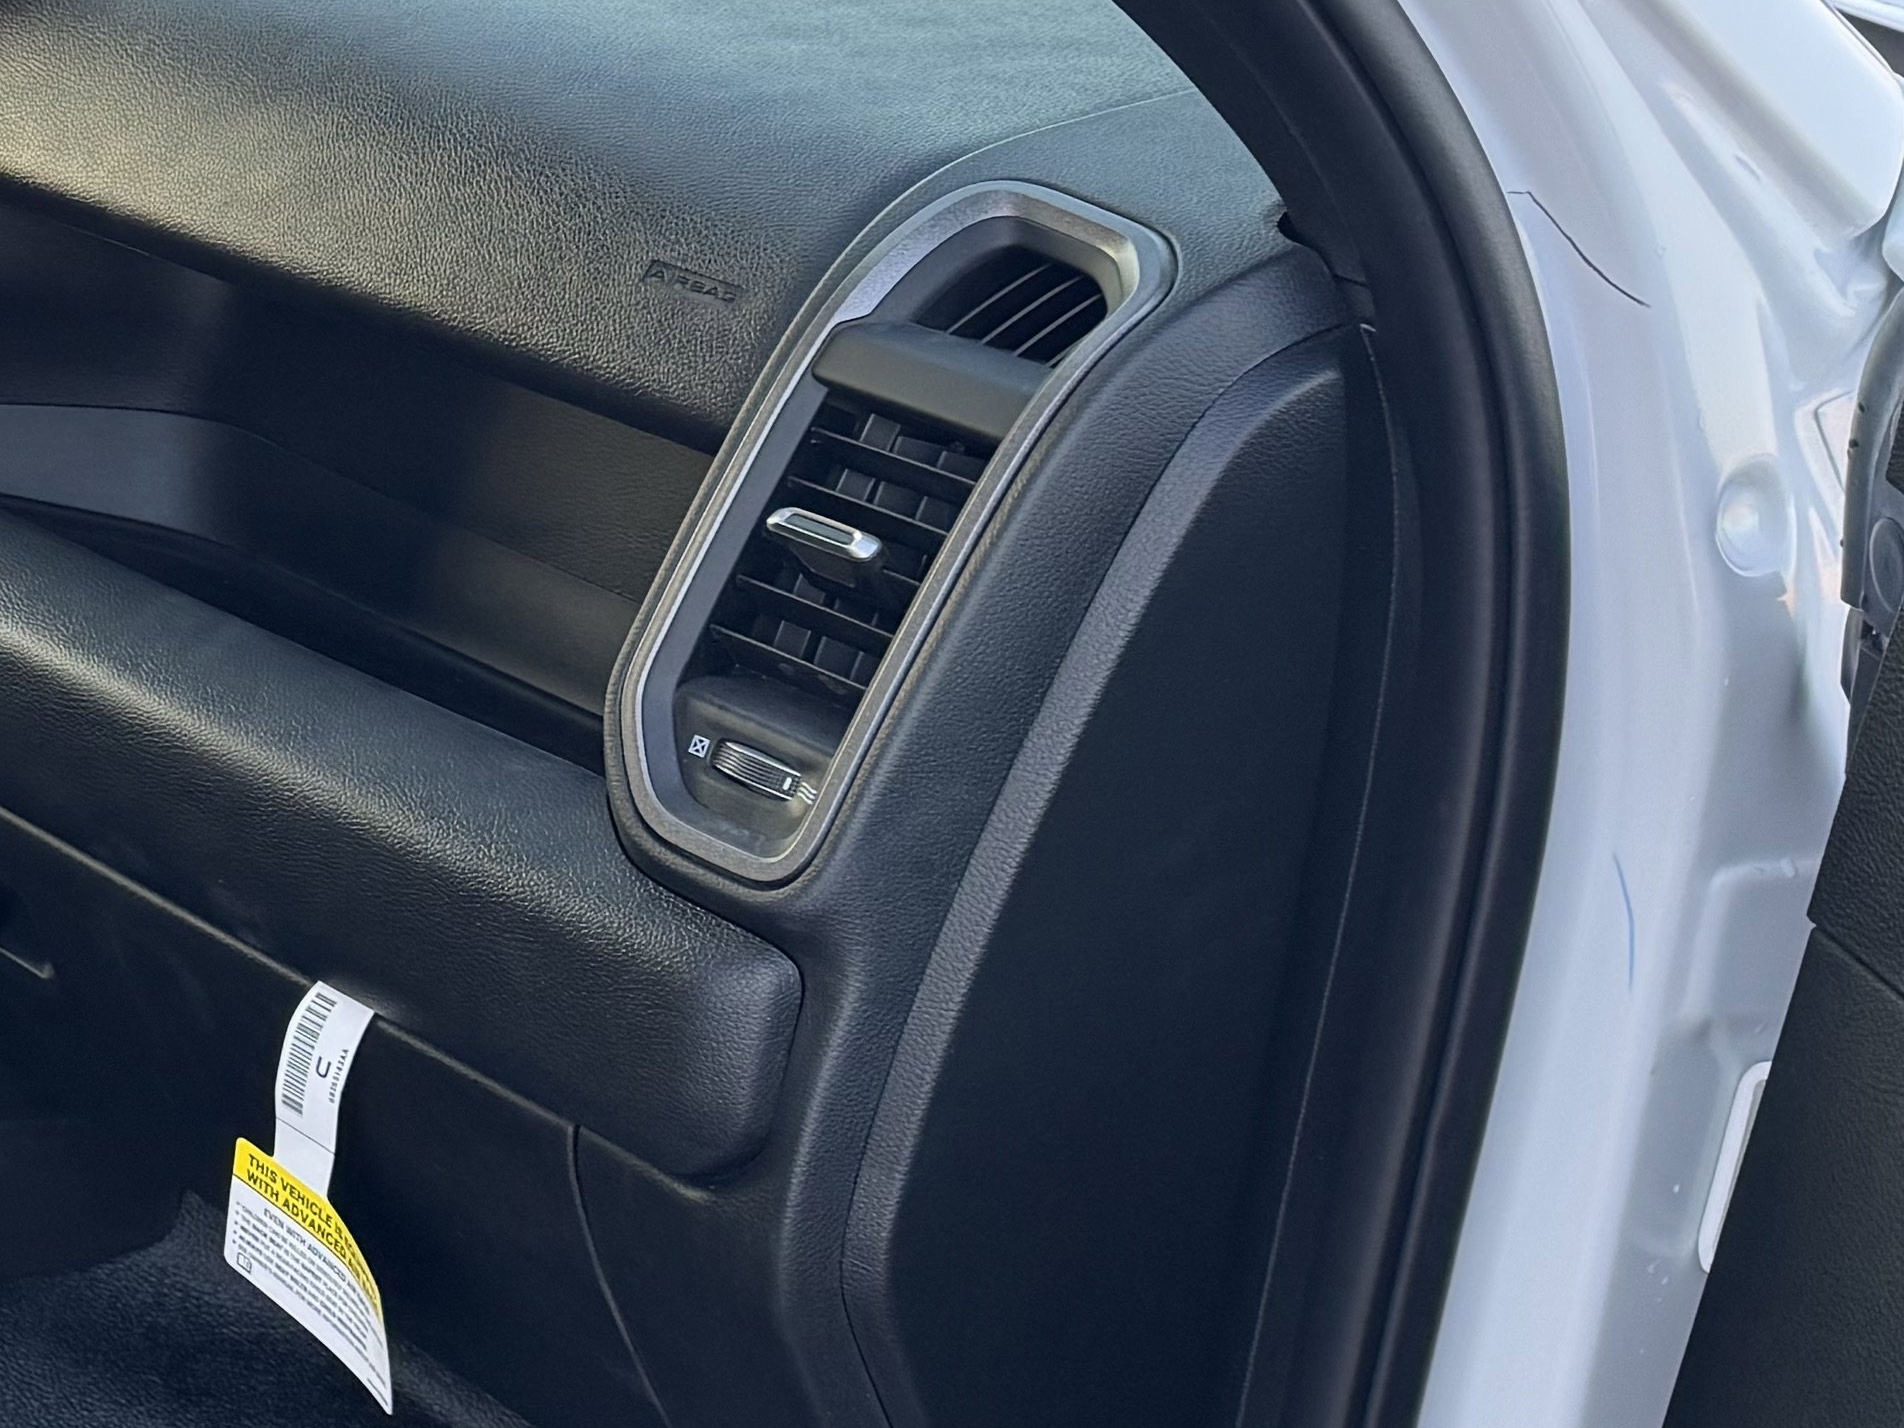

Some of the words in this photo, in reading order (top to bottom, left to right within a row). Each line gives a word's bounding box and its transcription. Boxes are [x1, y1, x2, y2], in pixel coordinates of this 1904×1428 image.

[246, 1169, 280, 1203] WITH
[282, 1198, 347, 1259] ADVANCED
[248, 1153, 278, 1183] THIS
[280, 1177, 333, 1228] VEHICLE
